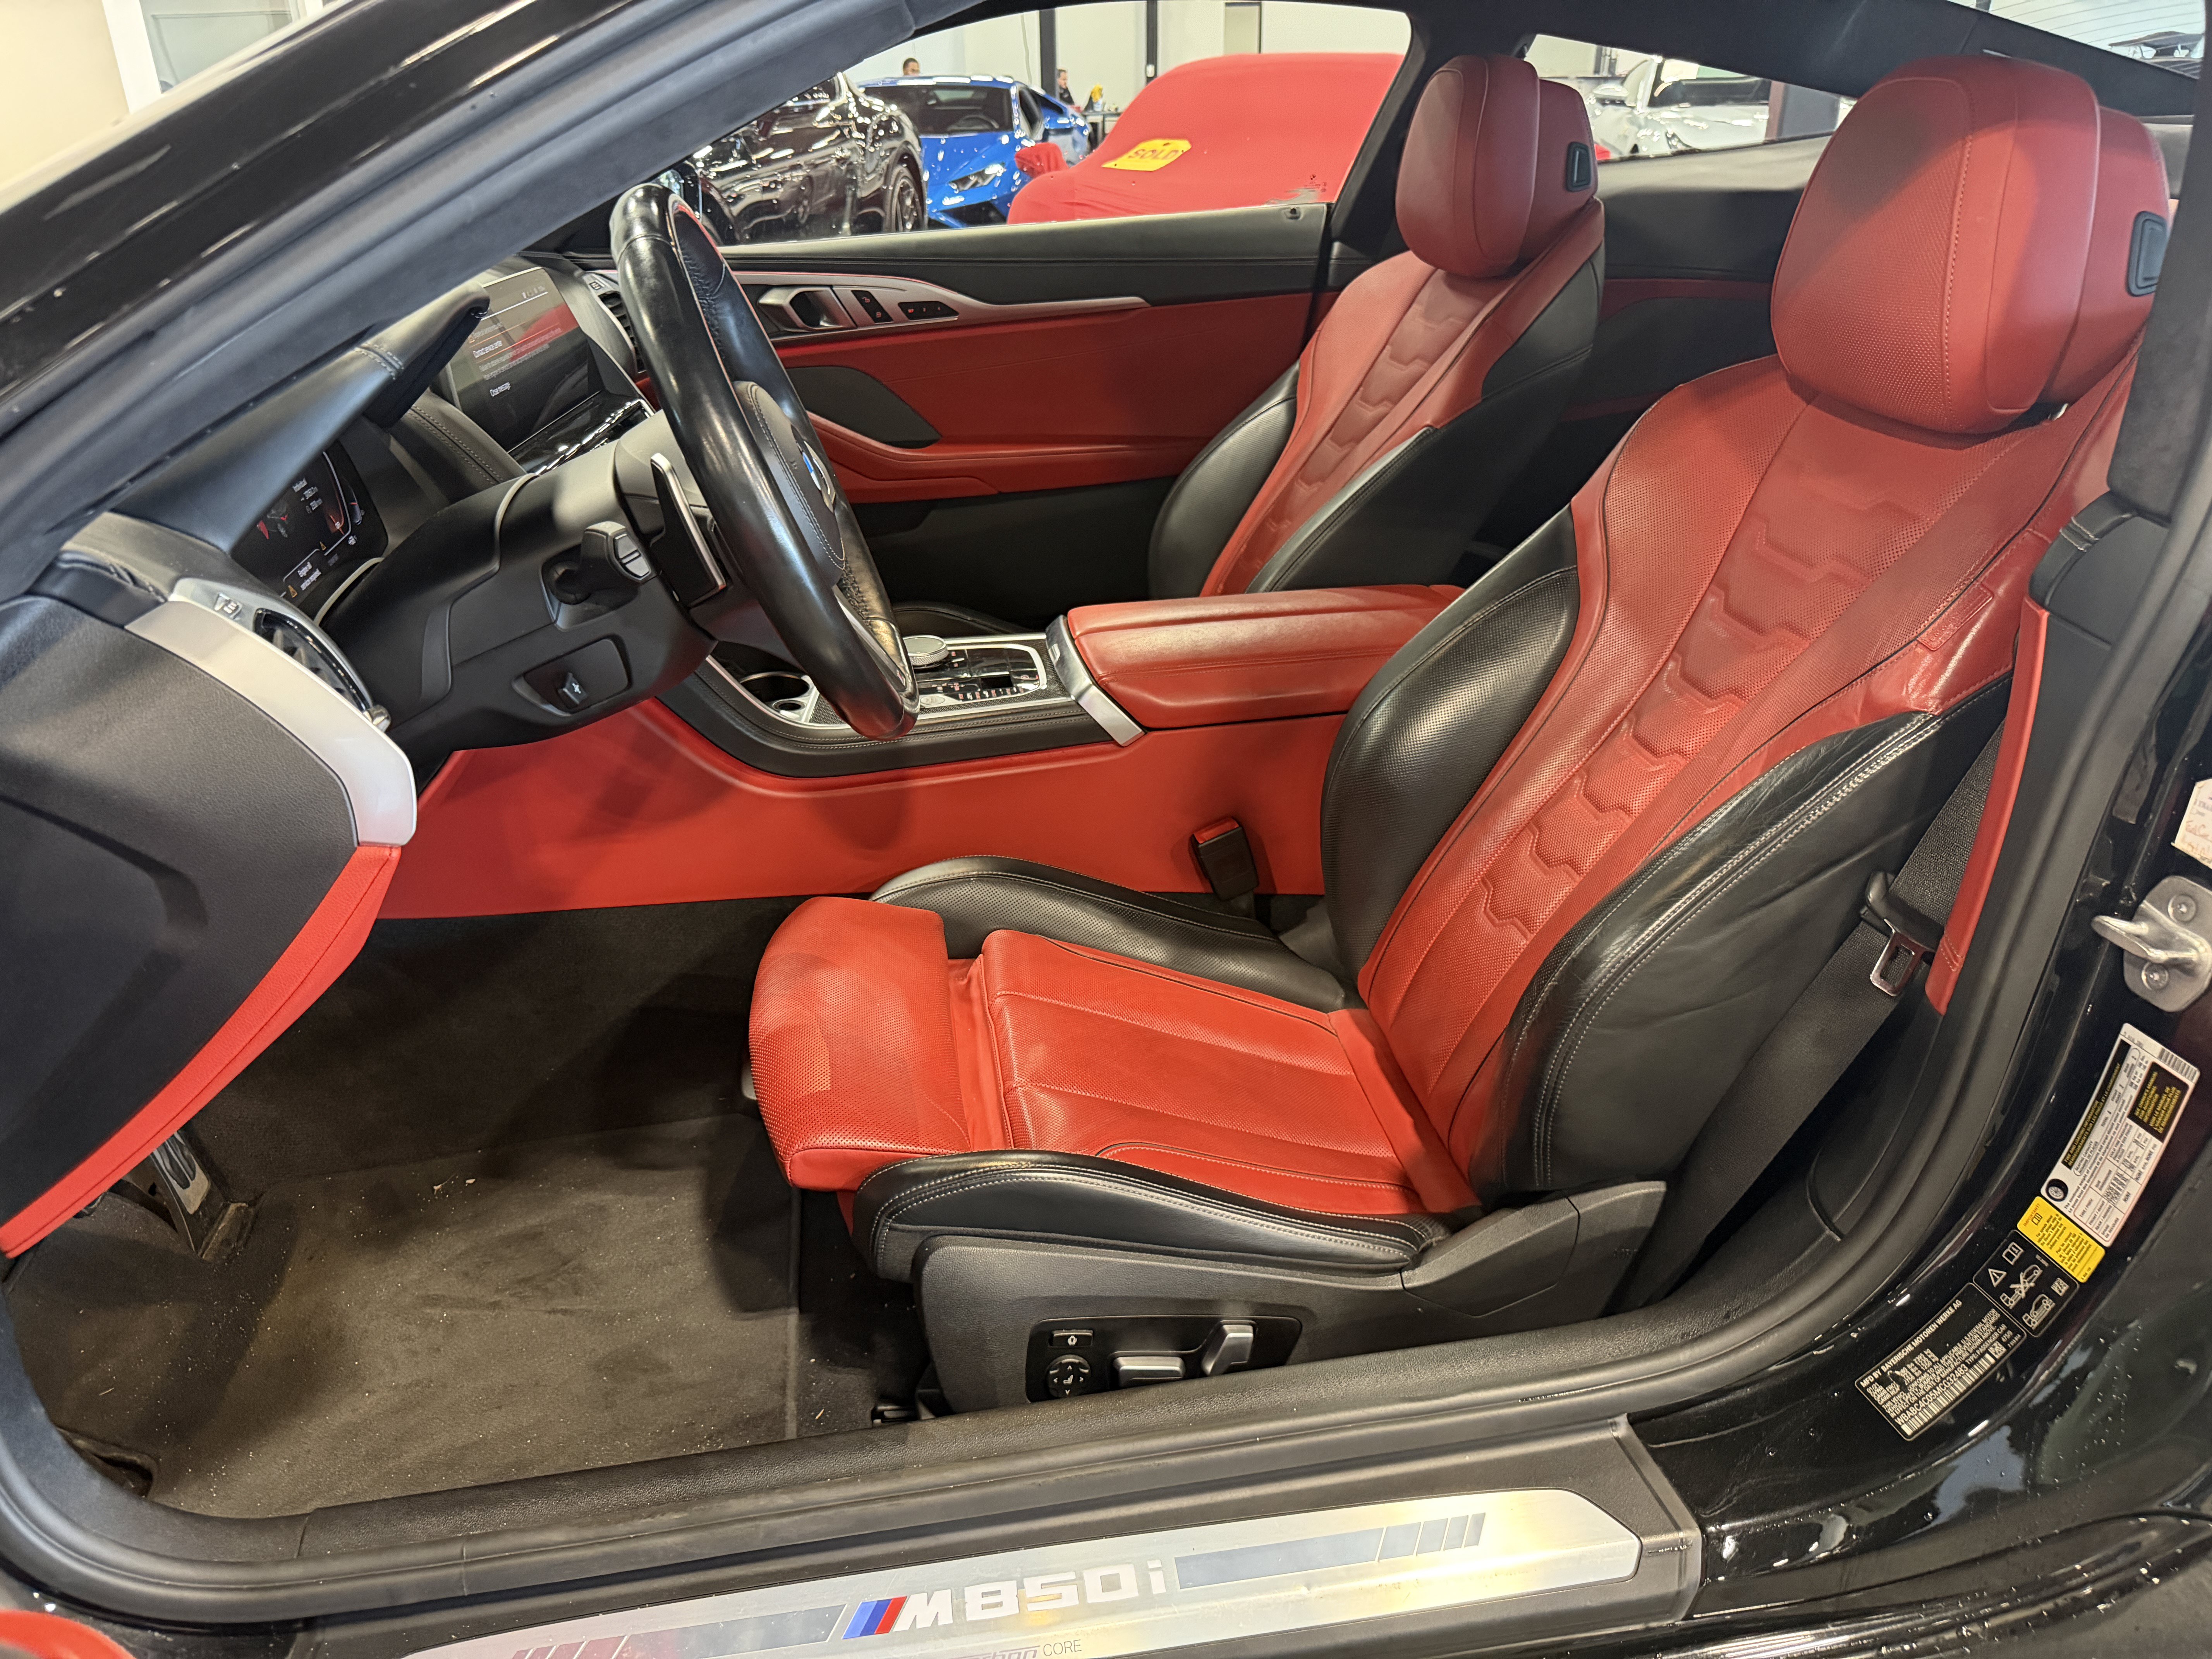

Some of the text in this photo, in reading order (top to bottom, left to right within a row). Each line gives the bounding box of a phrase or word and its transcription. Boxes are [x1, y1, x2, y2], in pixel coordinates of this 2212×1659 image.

[1127, 149, 1179, 160] SOLD
[1859, 1299, 1963, 1388] MFD BY BAYERISCHE MOTOREN WERKE AG
[1965, 1352, 1979, 1365] TYPE:
[1975, 1331, 2000, 1355] PASSENGER
[1996, 1323, 2008, 1334] CAR
[1866, 1382, 1879, 1393] 01/21
[1043, 1639, 1082, 1656] CORE
